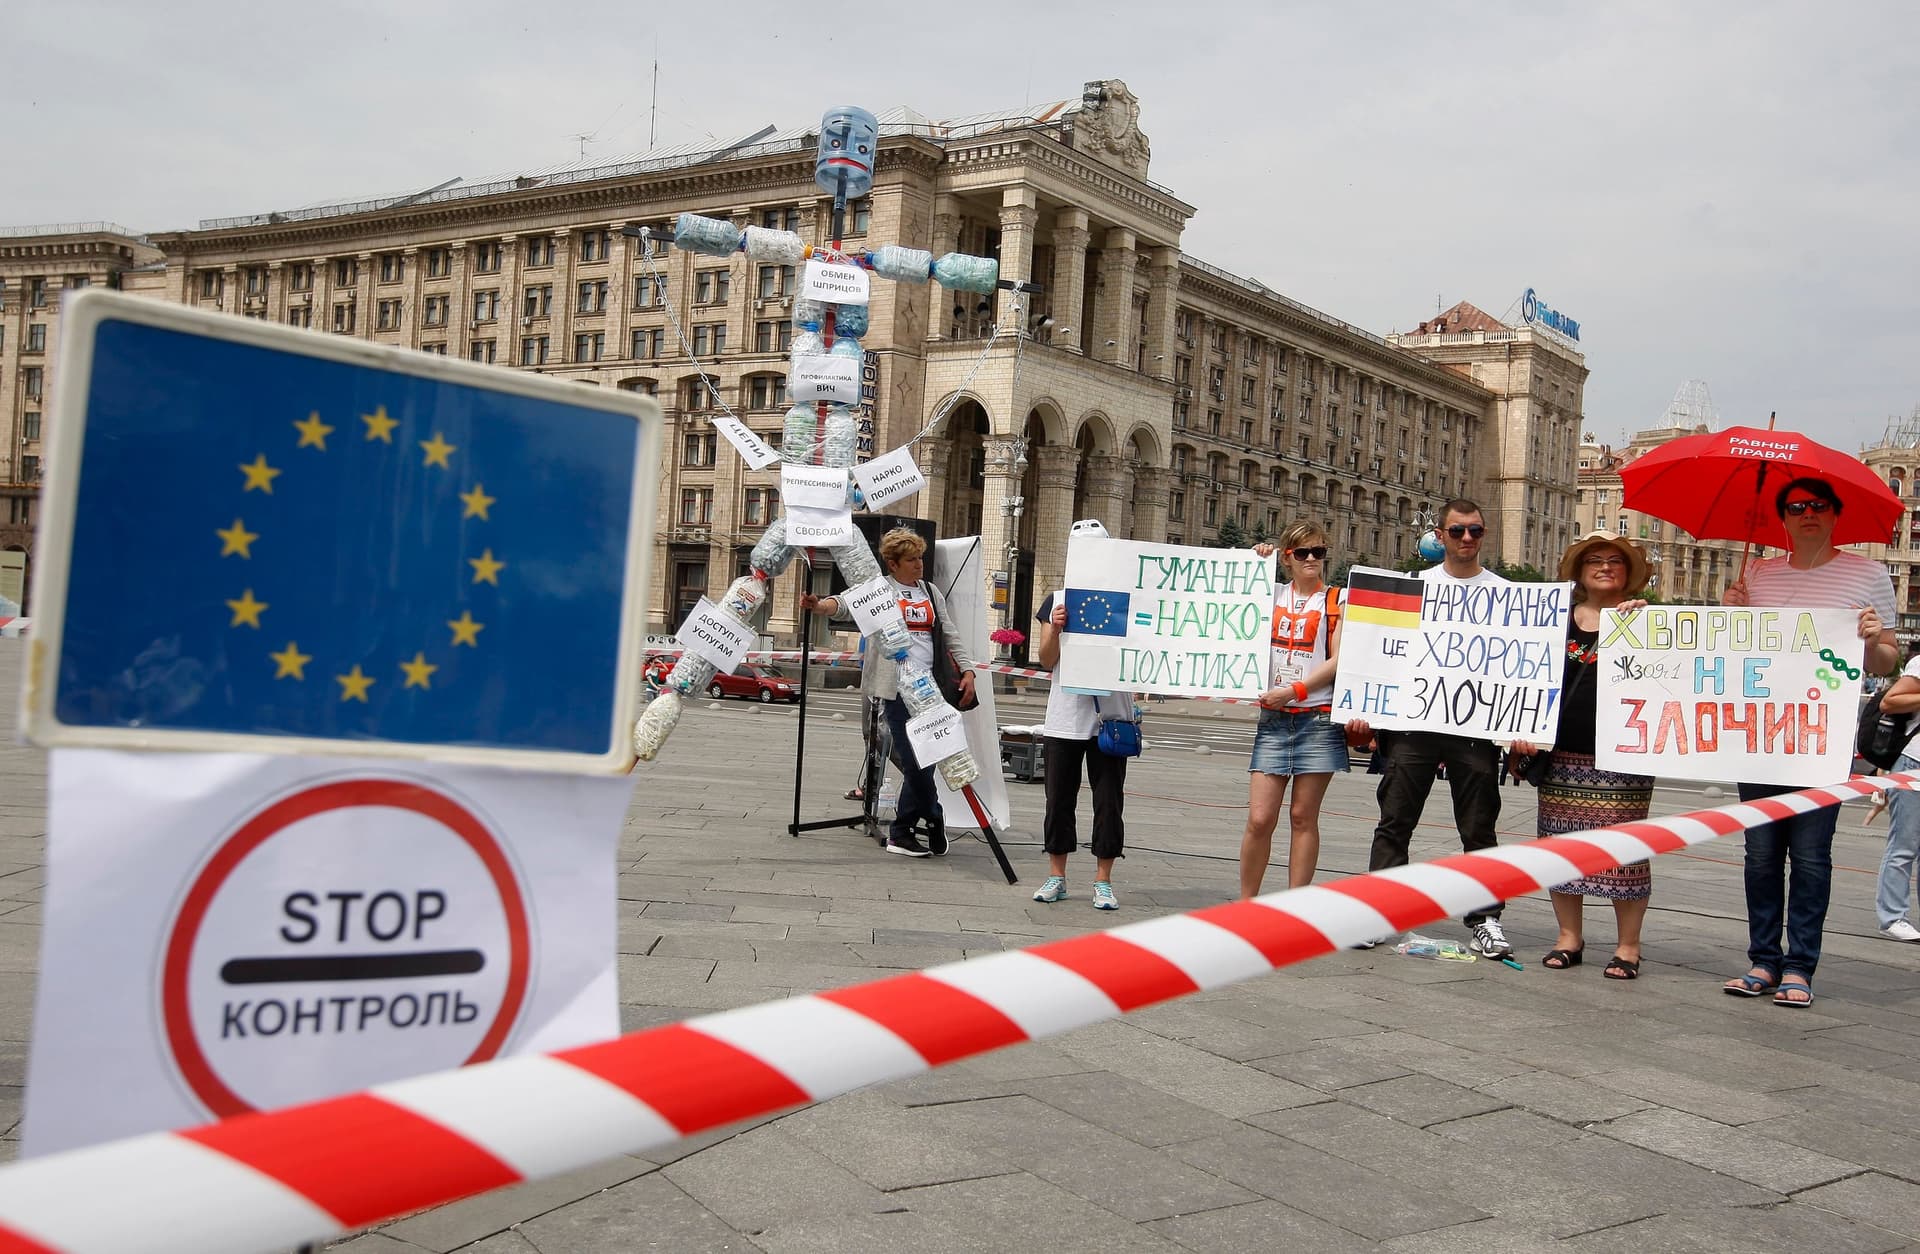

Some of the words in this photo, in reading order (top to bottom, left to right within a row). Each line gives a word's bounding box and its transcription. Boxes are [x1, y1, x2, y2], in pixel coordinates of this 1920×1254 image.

[820, 269, 856, 281] ОБМЕН
[812, 280, 862, 294] ШПРИЦОВ
[800, 373, 852, 382] ПРОФИЛАКТИКА
[816, 383, 836, 393] ВИЧ
[729, 423, 766, 459] ЦЕПИ
[1728, 436, 1799, 452] РАВНЫЕ
[1730, 447, 1793, 461] ПРАВА!
[786, 477, 842, 490] РЕПРЕССИВНОЙ
[871, 463, 903, 485] НАРКО
[870, 474, 918, 502] ПОЛИТИКИ
[795, 526, 845, 537] СВОБОДА
[1135, 554, 1271, 596] ГУМАННА
[697, 612, 735, 642] ДОСТУП
[734, 637, 743, 647] К
[1600, 610, 1820, 653] ХВОРОБА
[692, 625, 734, 658] УСЛУГАМ
[1383, 638, 1409, 658] ЦЕ
[1693, 656, 1771, 697] НЕ
[1361, 682, 1399, 717] НЕ
[1407, 676, 1560, 734] ЗЛОЧИН!
[933, 727, 951, 740] ВГС
[279, 890, 446, 945] STOP
[221, 990, 481, 1040] КОНТРОЛЬ
